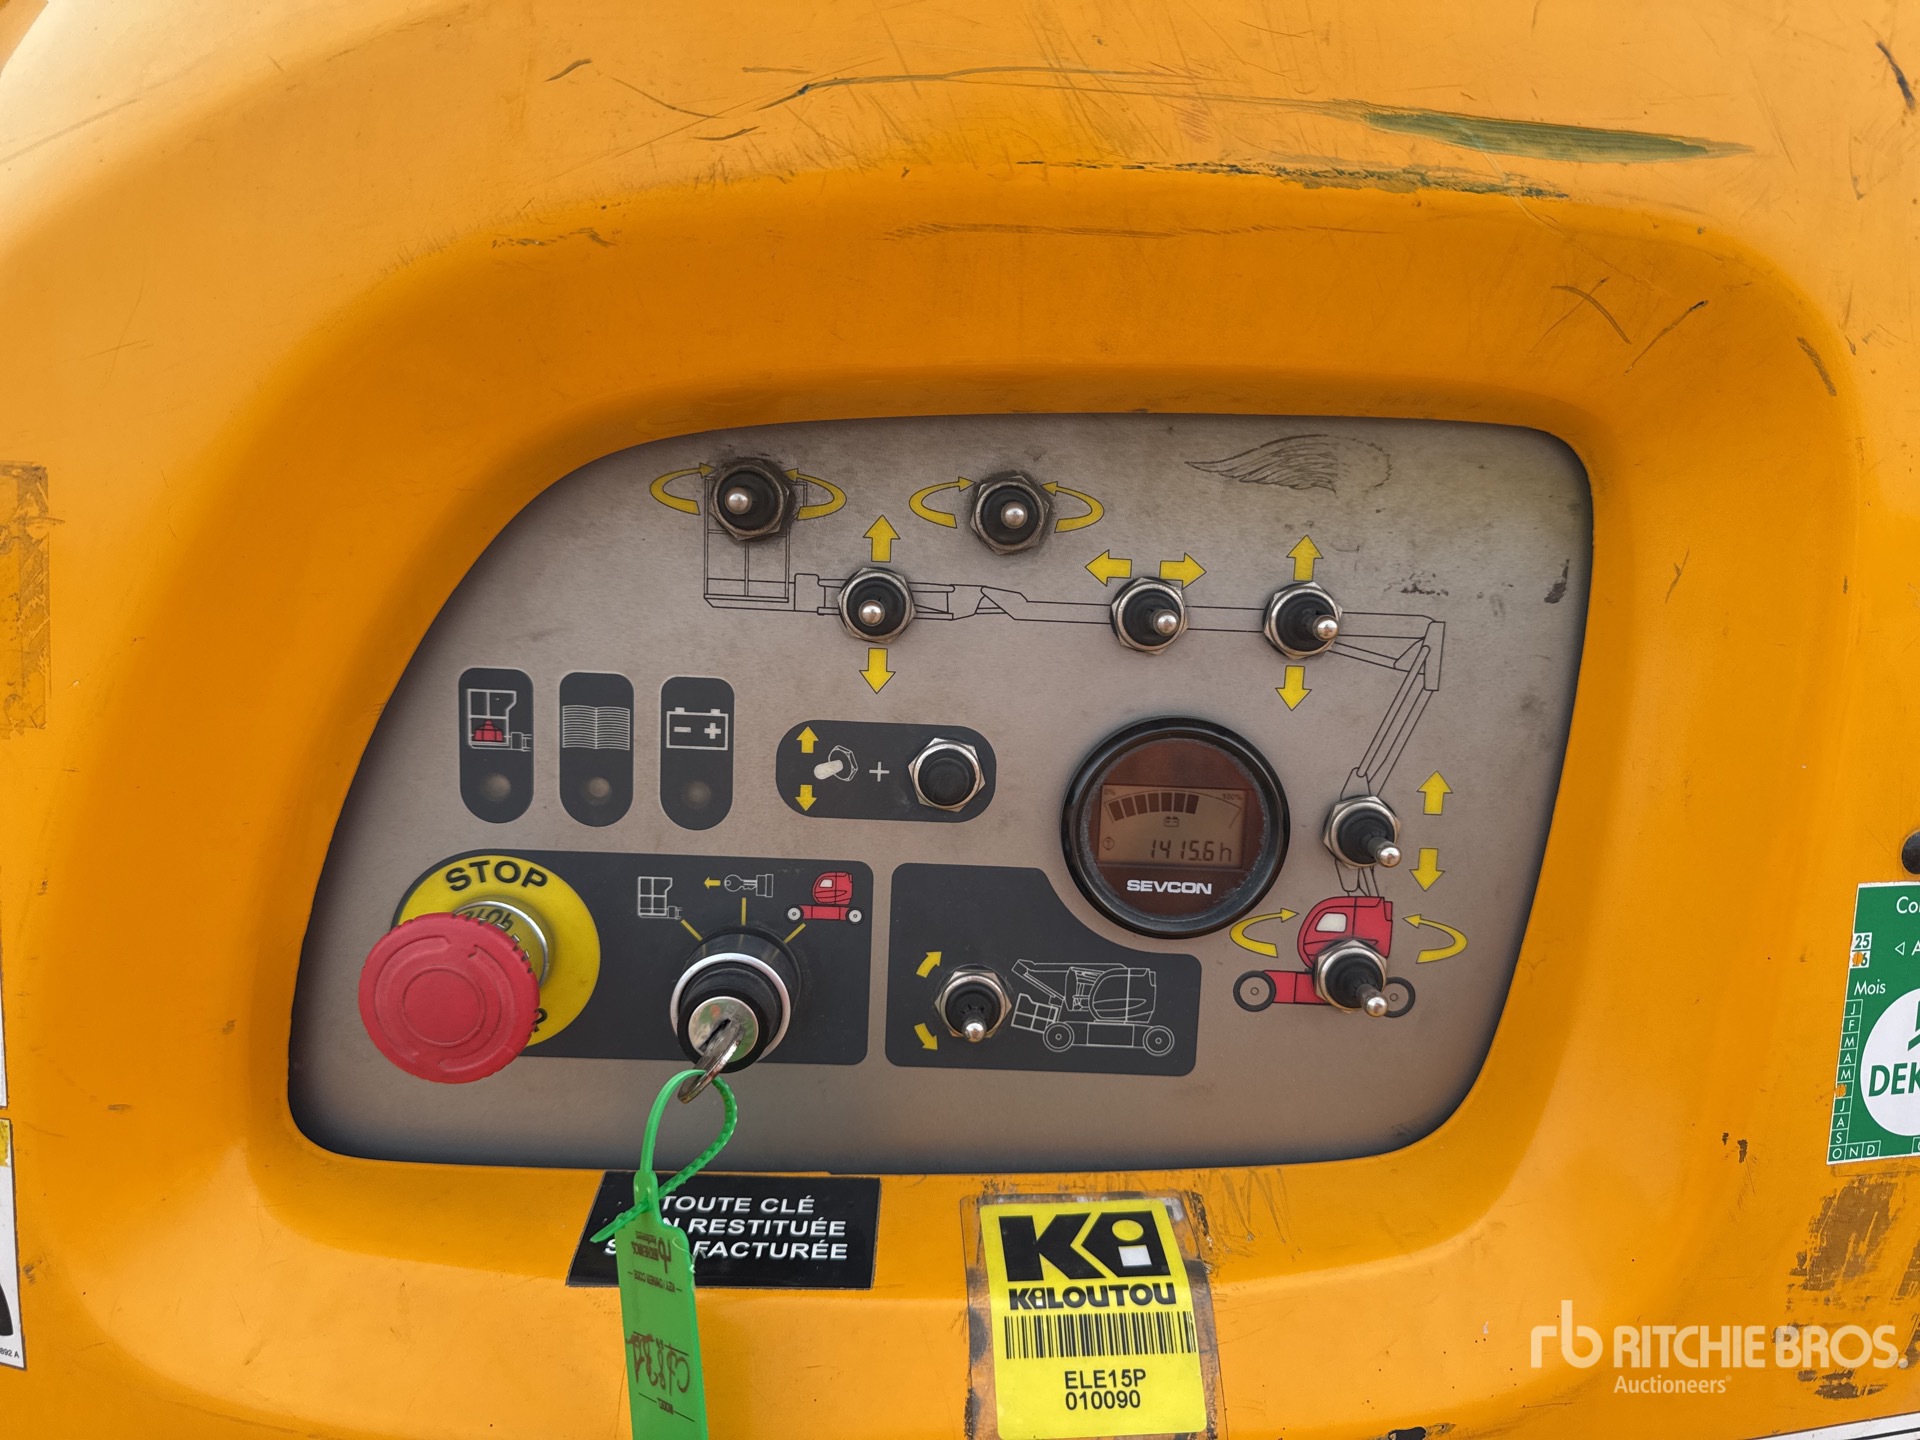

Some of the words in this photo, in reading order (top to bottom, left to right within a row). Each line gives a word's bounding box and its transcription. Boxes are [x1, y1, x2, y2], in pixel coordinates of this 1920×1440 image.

[446, 860, 548, 891] STOP
[1126, 879, 1212, 895] SEVCON
[1854, 934, 1870, 949] 25
[1852, 952, 1869, 967] 6
[1853, 978, 1886, 996] Mois
[662, 1195, 752, 1213] TOUTE
[760, 1195, 815, 1214] CLÉ
[687, 1217, 847, 1236] RESTITUÉE
[693, 1239, 848, 1260] FACTURÉE
[1064, 1368, 1146, 1390] ELE15P
[1065, 1390, 1141, 1411] 010090
